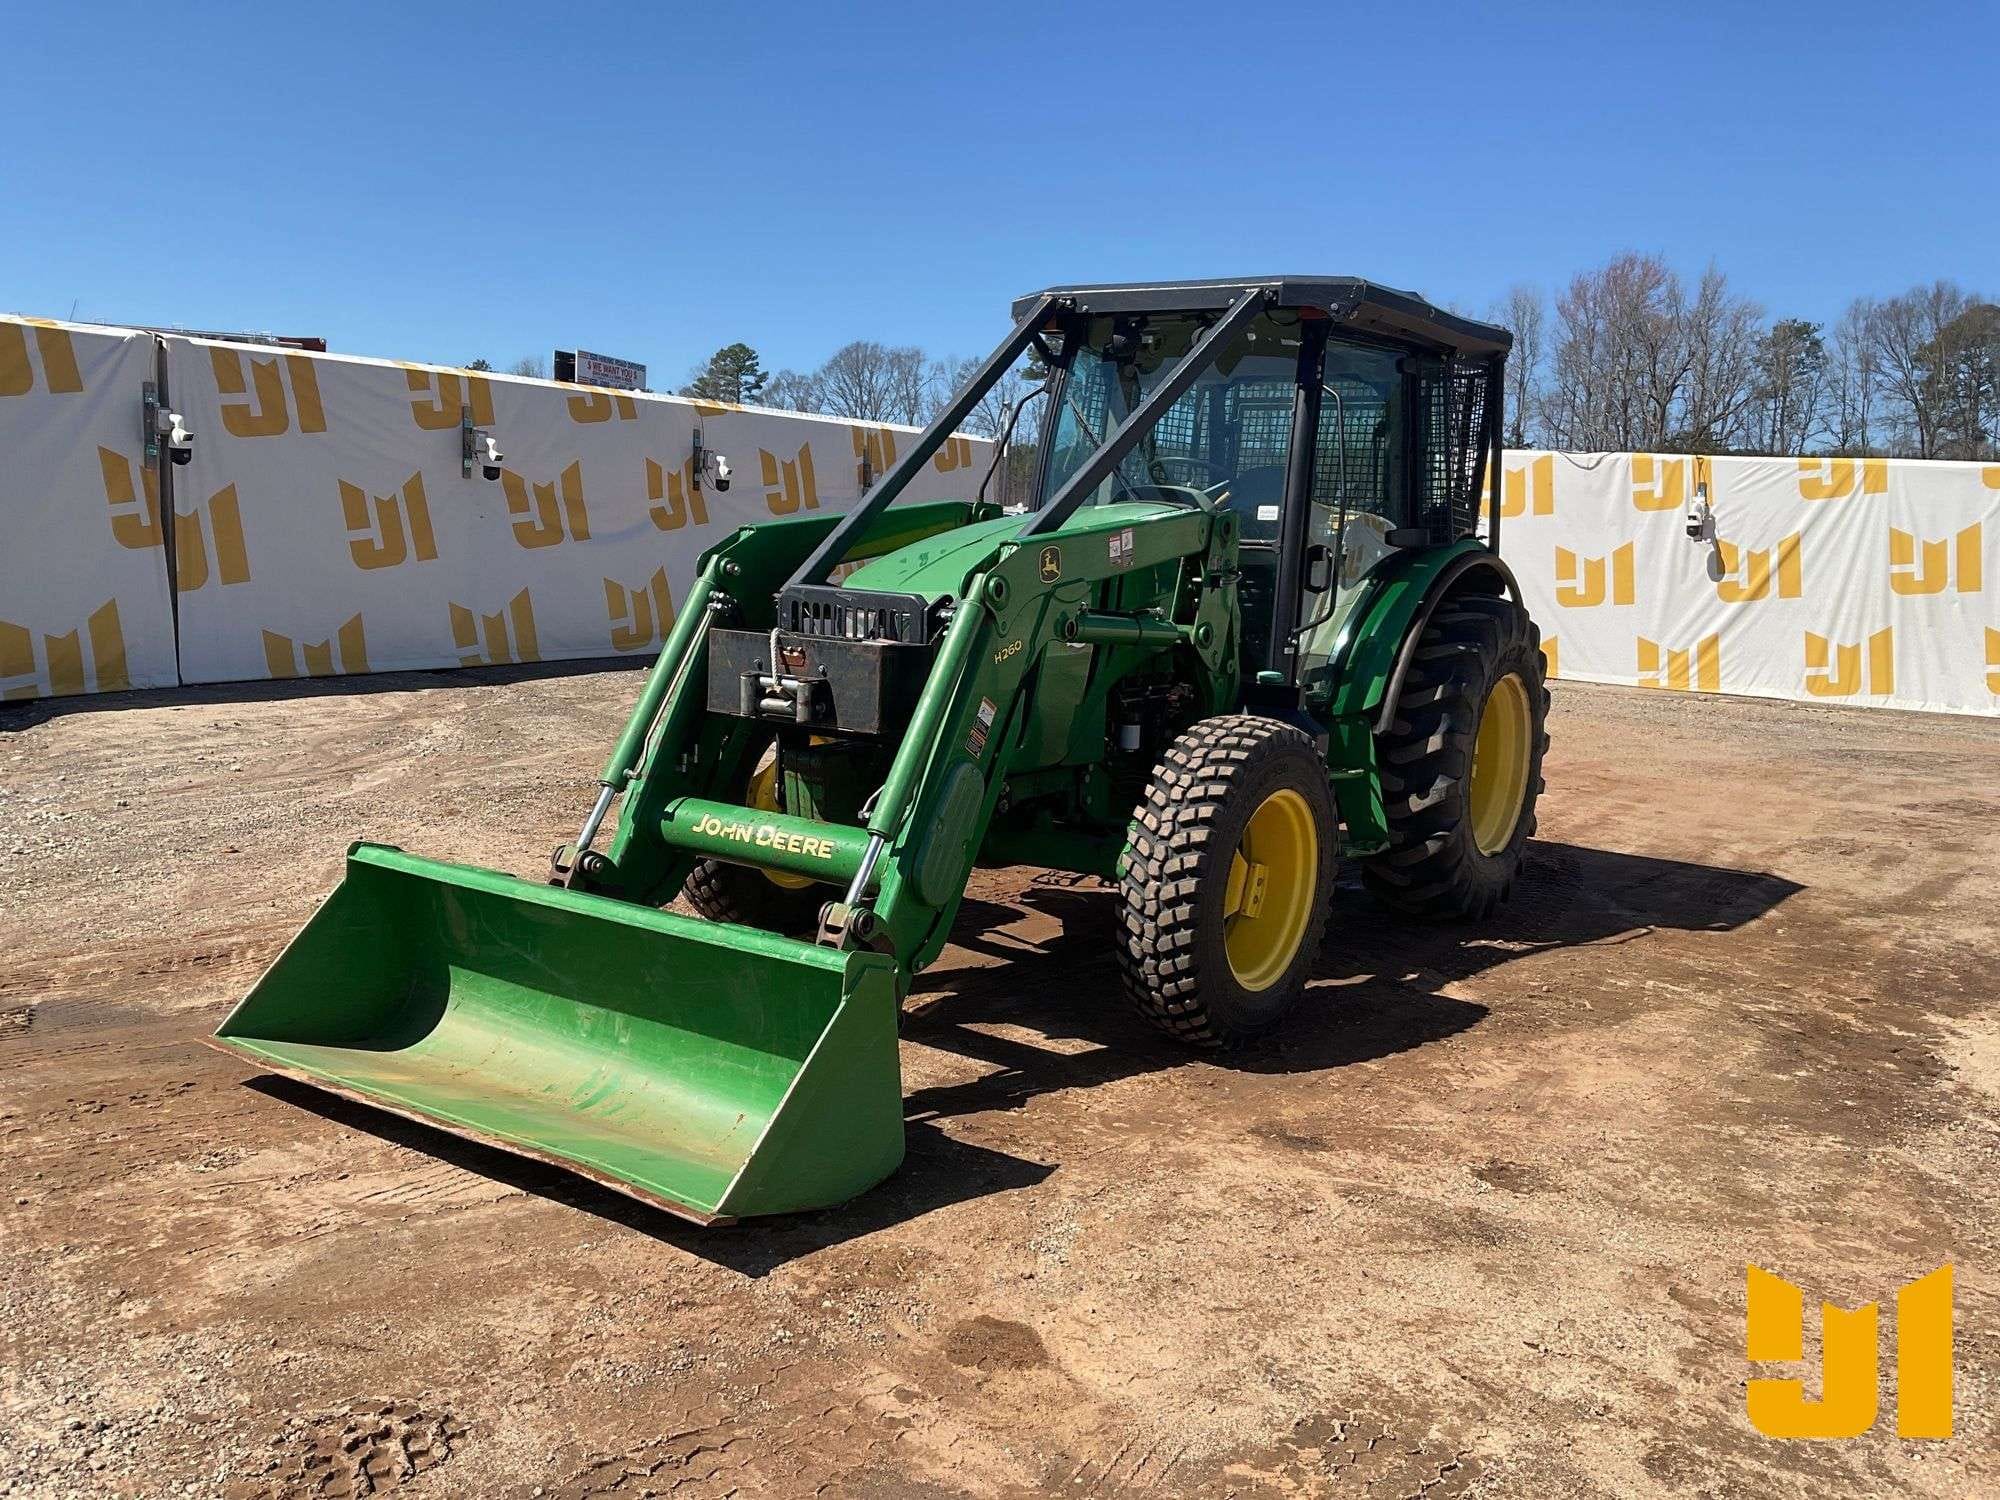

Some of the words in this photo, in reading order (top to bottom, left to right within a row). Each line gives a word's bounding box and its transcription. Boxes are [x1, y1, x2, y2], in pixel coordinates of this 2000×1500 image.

[592, 361, 602, 373] WE
[602, 363, 620, 376] WANT
[620, 366, 633, 379] YOU
[994, 640, 1022, 664] H260
[692, 813, 753, 843] JOHN
[755, 825, 835, 859] DEERE
